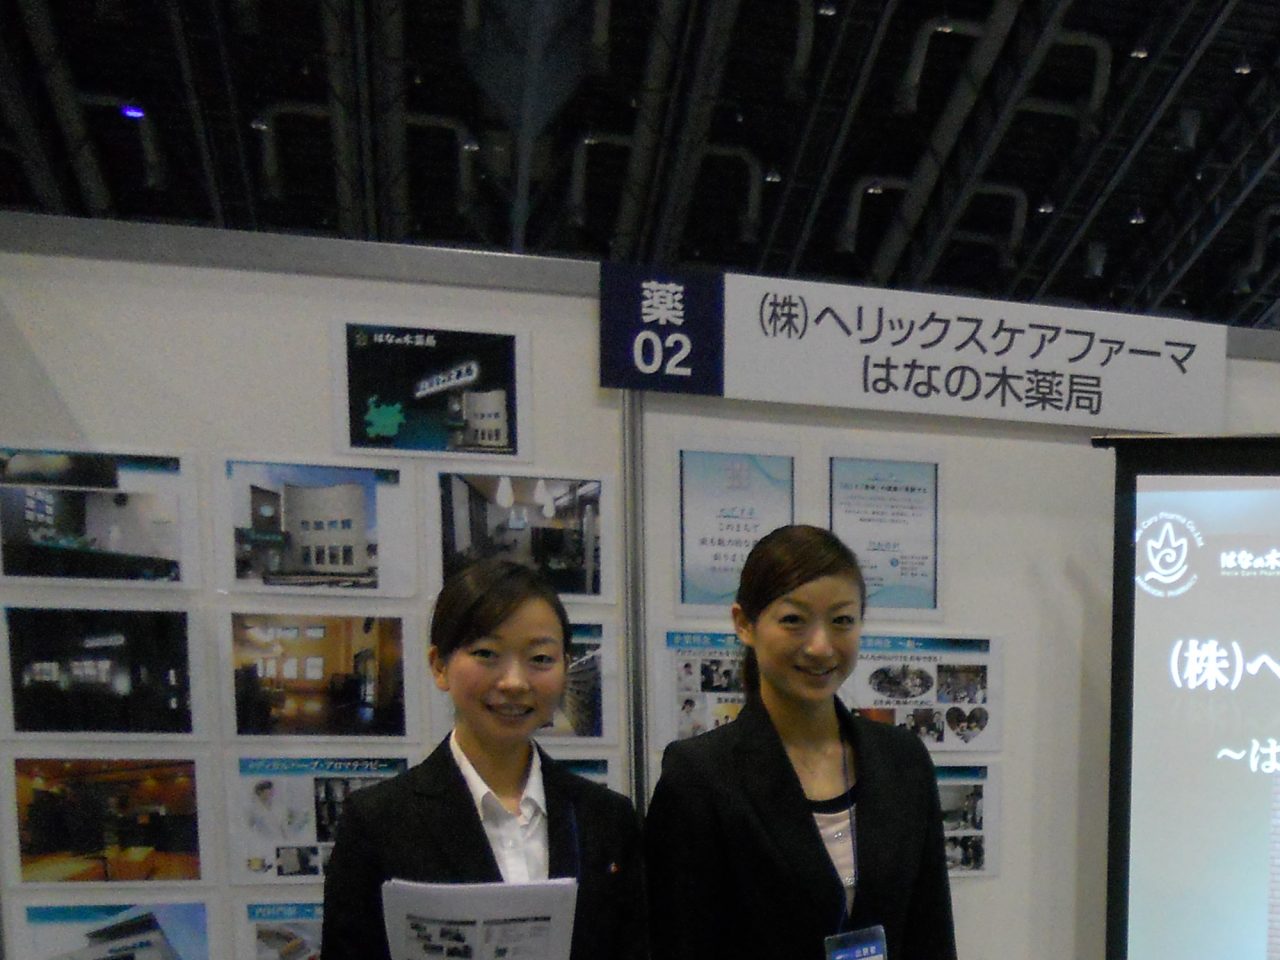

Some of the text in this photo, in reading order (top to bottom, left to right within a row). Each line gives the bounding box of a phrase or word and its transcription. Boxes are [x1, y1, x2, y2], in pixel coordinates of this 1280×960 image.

[641, 281, 684, 326] 薬
[632, 331, 692, 376] 02
[758, 291, 1197, 375] (株)ヘリックスケアファーマ
[862, 355, 1103, 415] はなの木薬局
